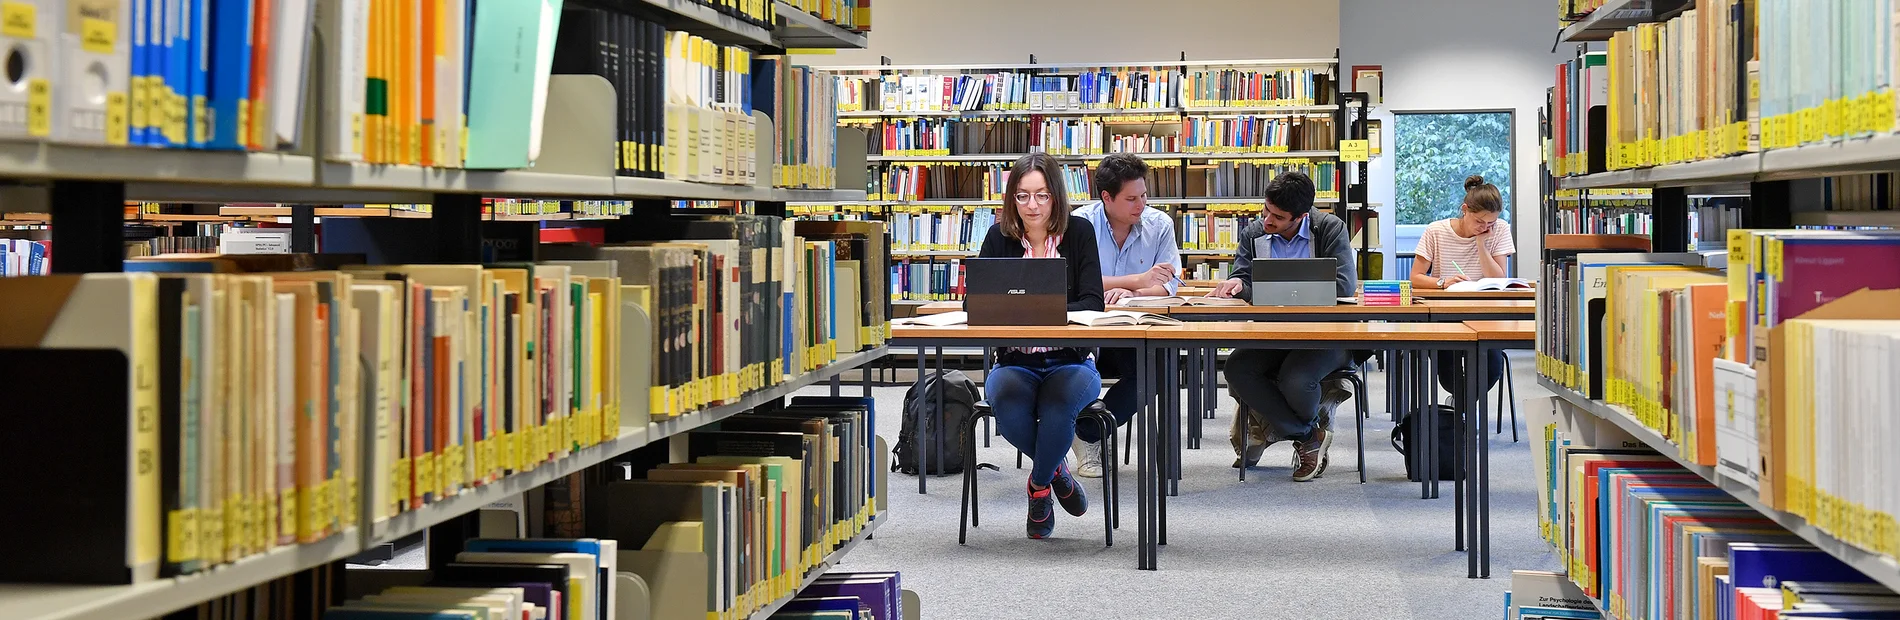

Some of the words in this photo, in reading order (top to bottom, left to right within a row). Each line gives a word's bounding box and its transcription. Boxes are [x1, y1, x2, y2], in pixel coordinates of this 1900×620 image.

[1593, 277, 1607, 288] En
[1622, 440, 1637, 448] Das
[1549, 596, 1582, 605] Psychologie
